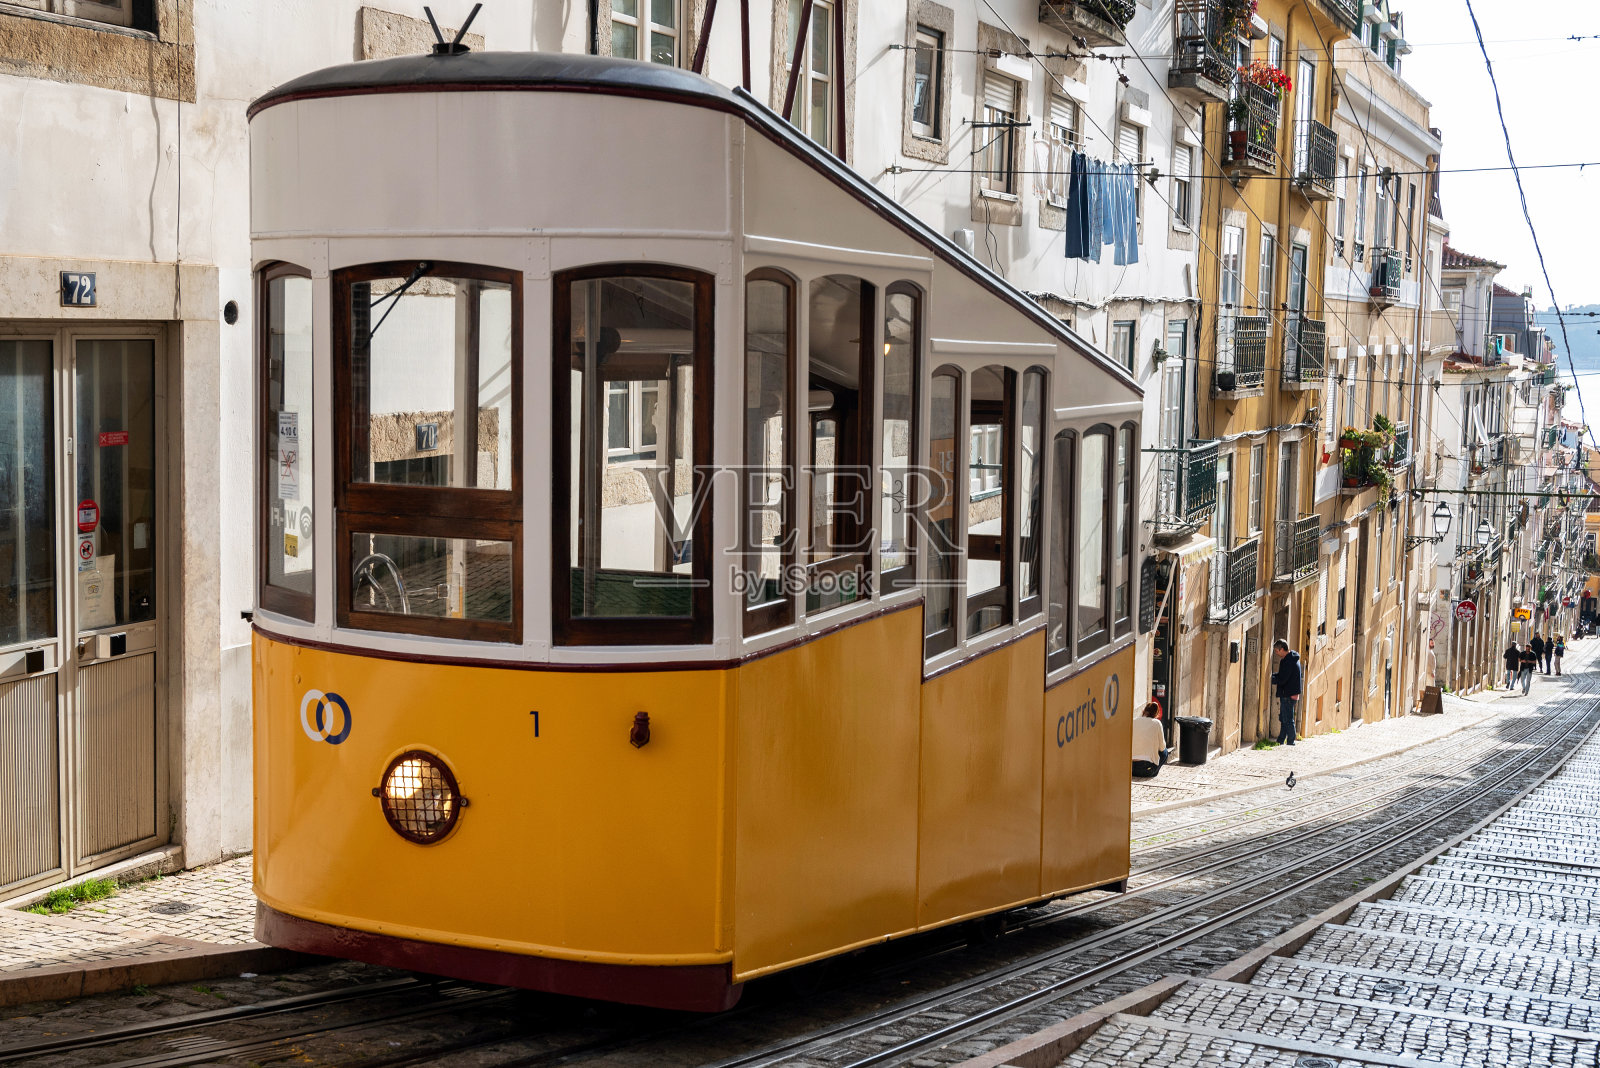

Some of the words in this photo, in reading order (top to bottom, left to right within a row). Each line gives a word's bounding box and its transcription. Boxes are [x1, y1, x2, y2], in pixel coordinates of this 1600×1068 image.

[68, 275, 91, 304] 72
[421, 425, 435, 449] 70
[529, 710, 539, 738] 1
[1057, 688, 1097, 748] carris
